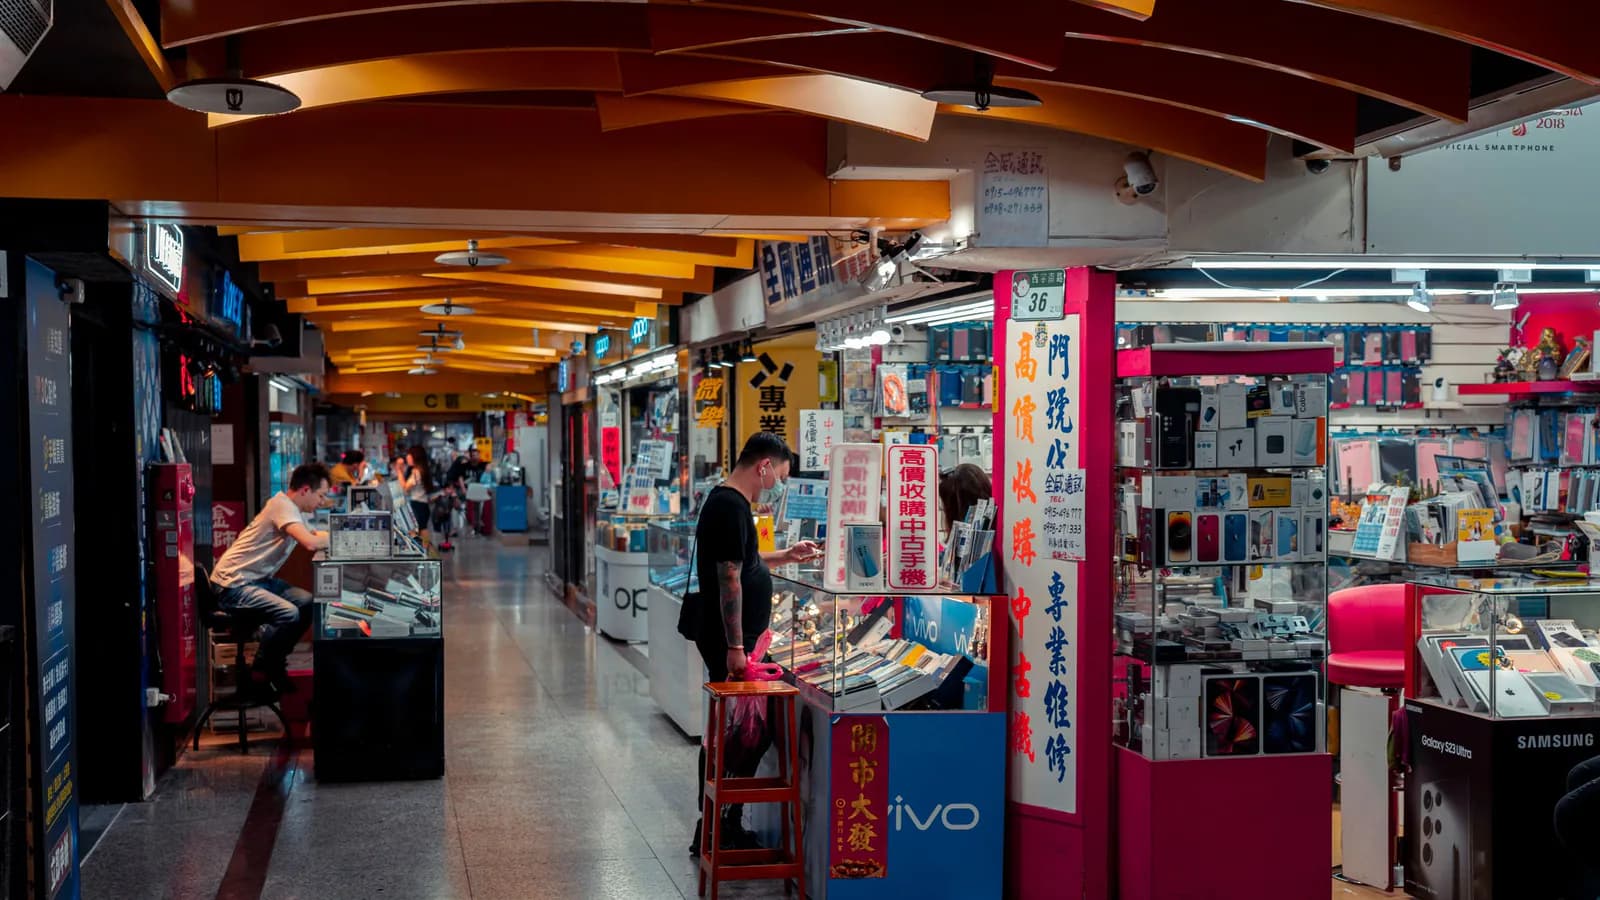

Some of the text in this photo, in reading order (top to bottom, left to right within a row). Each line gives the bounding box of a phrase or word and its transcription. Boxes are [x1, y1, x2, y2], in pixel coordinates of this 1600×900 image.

[1536, 117, 1565, 129] 2018
[1485, 144, 1555, 152] SMARTPHONE
[1028, 292, 1048, 312] 36
[898, 449, 927, 586] 高價收購中古手機
[1011, 331, 1037, 764] 高價收購中古機
[912, 611, 939, 643] vivo
[1421, 734, 1473, 759] Galaxy S23 Ultra
[1517, 733, 1594, 749] SAMSUNG
[847, 723, 878, 852] 開市大發
[887, 794, 980, 831] ivo
